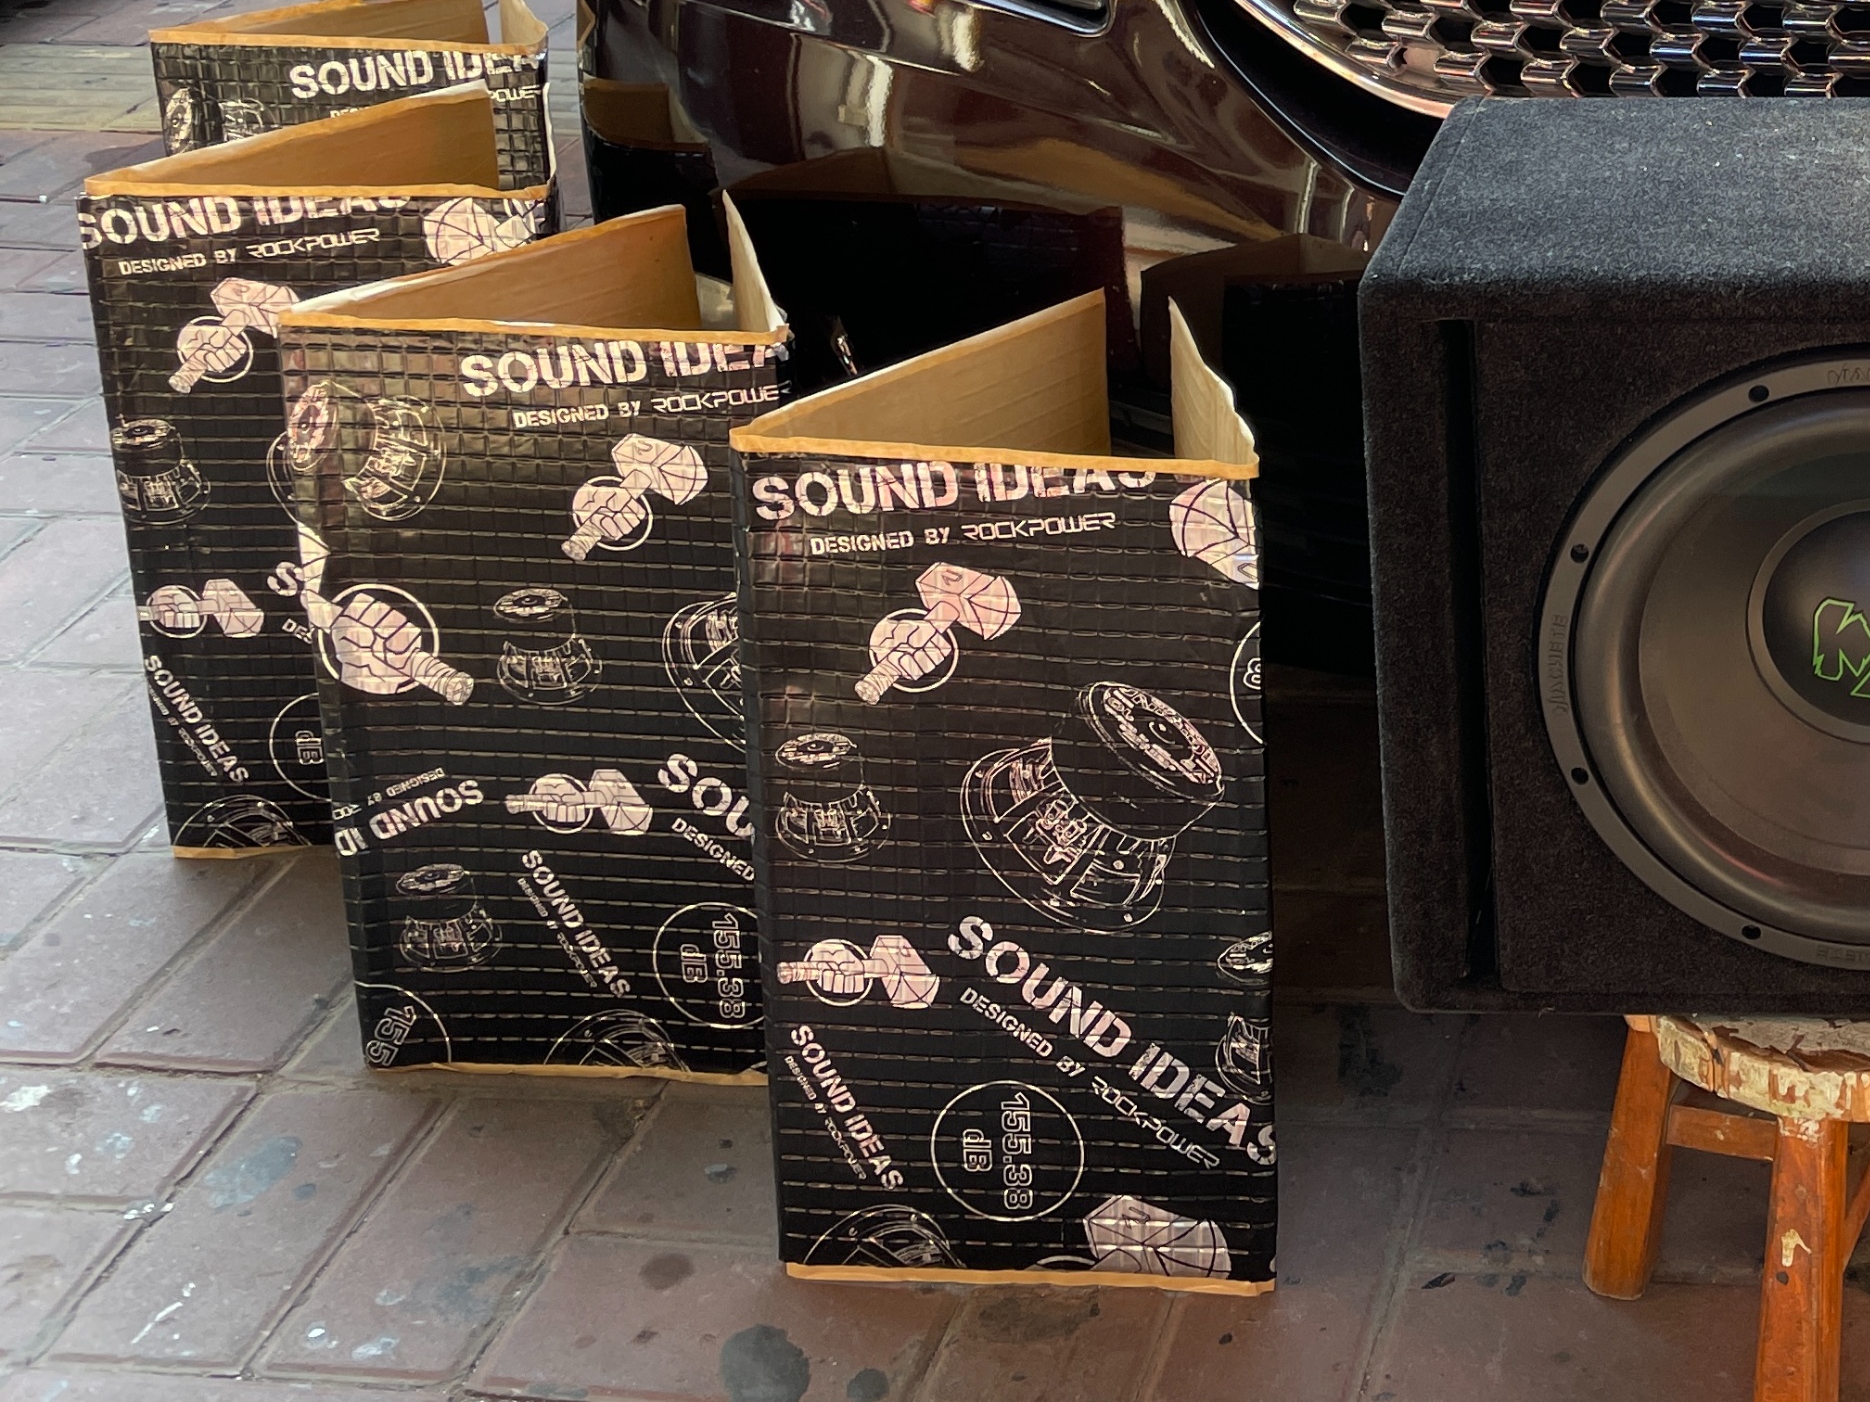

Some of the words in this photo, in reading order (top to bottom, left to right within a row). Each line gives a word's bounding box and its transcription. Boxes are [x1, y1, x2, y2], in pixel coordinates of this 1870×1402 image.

[289, 50, 433, 98] SOUND
[77, 195, 242, 250] SOUND
[119, 253, 207, 276] DESIGNED
[215, 246, 237, 265] BY
[247, 228, 381, 260] ROCKPOWER
[460, 340, 648, 397] SOUND
[512, 404, 610, 429] DESIGNED
[618, 401, 641, 417] BY
[752, 461, 960, 522] SOUND
[809, 530, 915, 556] DESIGNED
[924, 526, 951, 546] BY
[961, 511, 1117, 541] ROCKPOWER
[144, 654, 204, 725] SOUND
[195, 723, 250, 784] IDEAS
[294, 730, 325, 766] dB
[367, 791, 382, 807] BY
[369, 779, 484, 841] SOUND
[386, 767, 446, 798] DESIGNED
[657, 753, 756, 846] SOU
[671, 817, 755, 882] DESIGNED
[520, 849, 585, 929] SOUND
[575, 929, 632, 998] IDEAS
[680, 943, 708, 984] dB
[712, 912, 745, 1020] 155.38
[365, 1005, 418, 1067] 155
[946, 915, 1132, 1059] SOUND
[1128, 1041, 1278, 1166] IDEAS
[784, 1055, 817, 1101] DESIGNED
[790, 1025, 857, 1113] SOUND
[844, 1114, 904, 1190] IDEAS
[959, 986, 1055, 1059] DESIGNED
[1055, 1055, 1086, 1078] BY
[1089, 1075, 1221, 1170] ROCKPOWER
[962, 1128, 994, 1173] dB
[1000, 1091, 1034, 1211] 155.38
